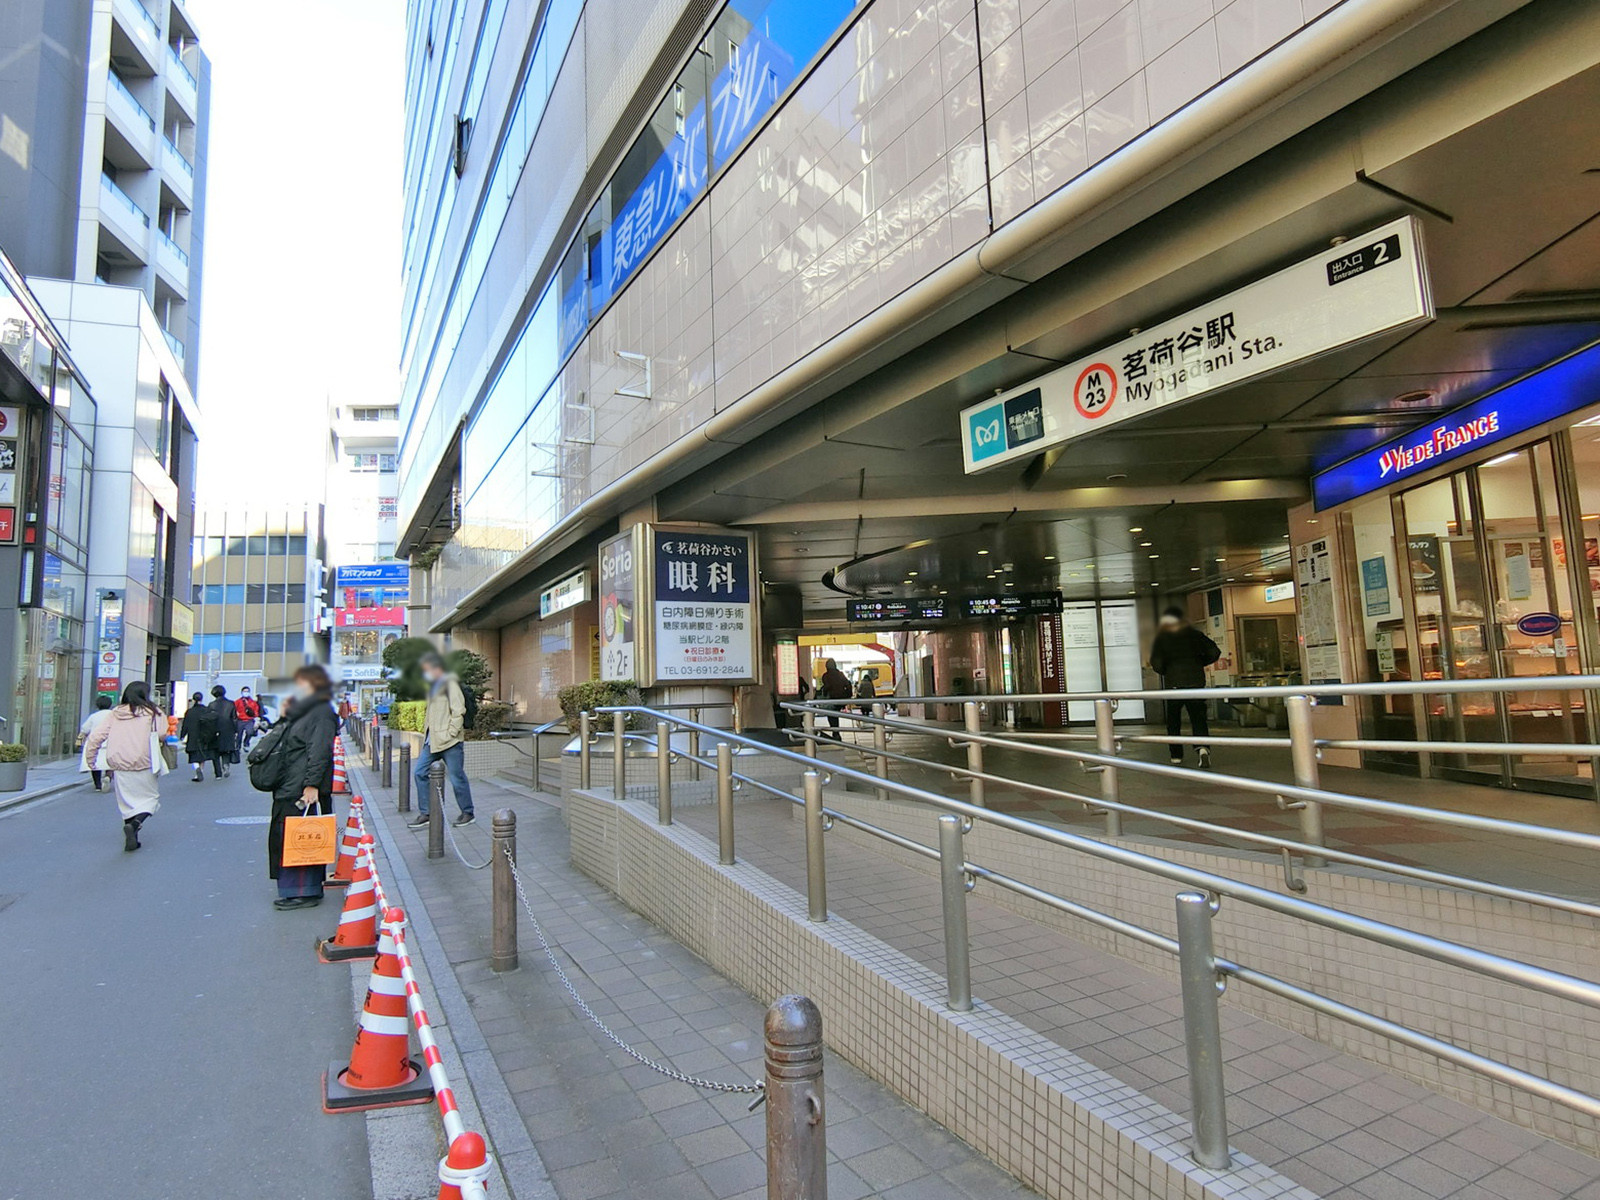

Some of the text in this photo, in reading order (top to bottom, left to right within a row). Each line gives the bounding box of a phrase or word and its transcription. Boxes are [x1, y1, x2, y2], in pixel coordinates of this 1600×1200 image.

[609, 40, 770, 291] 東急リバブル
[1372, 242, 1390, 265] 2
[1332, 253, 1363, 274] 出入口
[1333, 265, 1364, 282] Entrance
[1122, 311, 1237, 383] 茗荷谷駅
[1125, 335, 1284, 403] Myogadani Sta.
[1087, 371, 1101, 390] M
[1085, 388, 1107, 409] 23
[1390, 411, 1499, 473] VIE DE FRANCE
[676, 541, 742, 557] 茗荷谷かさい
[602, 544, 632, 581] Seria
[341, 568, 383, 577] アパマンショップ
[668, 560, 737, 594] 眼科
[937, 598, 944, 609] 2
[1054, 597, 1059, 607] 1
[662, 606, 744, 619] 白内障日帰り手術
[663, 621, 744, 631] 糖尿病網膜症・緑内障
[679, 635, 730, 644] 当駅ビル2階
[690, 647, 720, 655] 祝日診療
[616, 649, 628, 676] 2F
[664, 665, 745, 675] TEL 03-6912-2844
[354, 668, 380, 677] SoftBa
